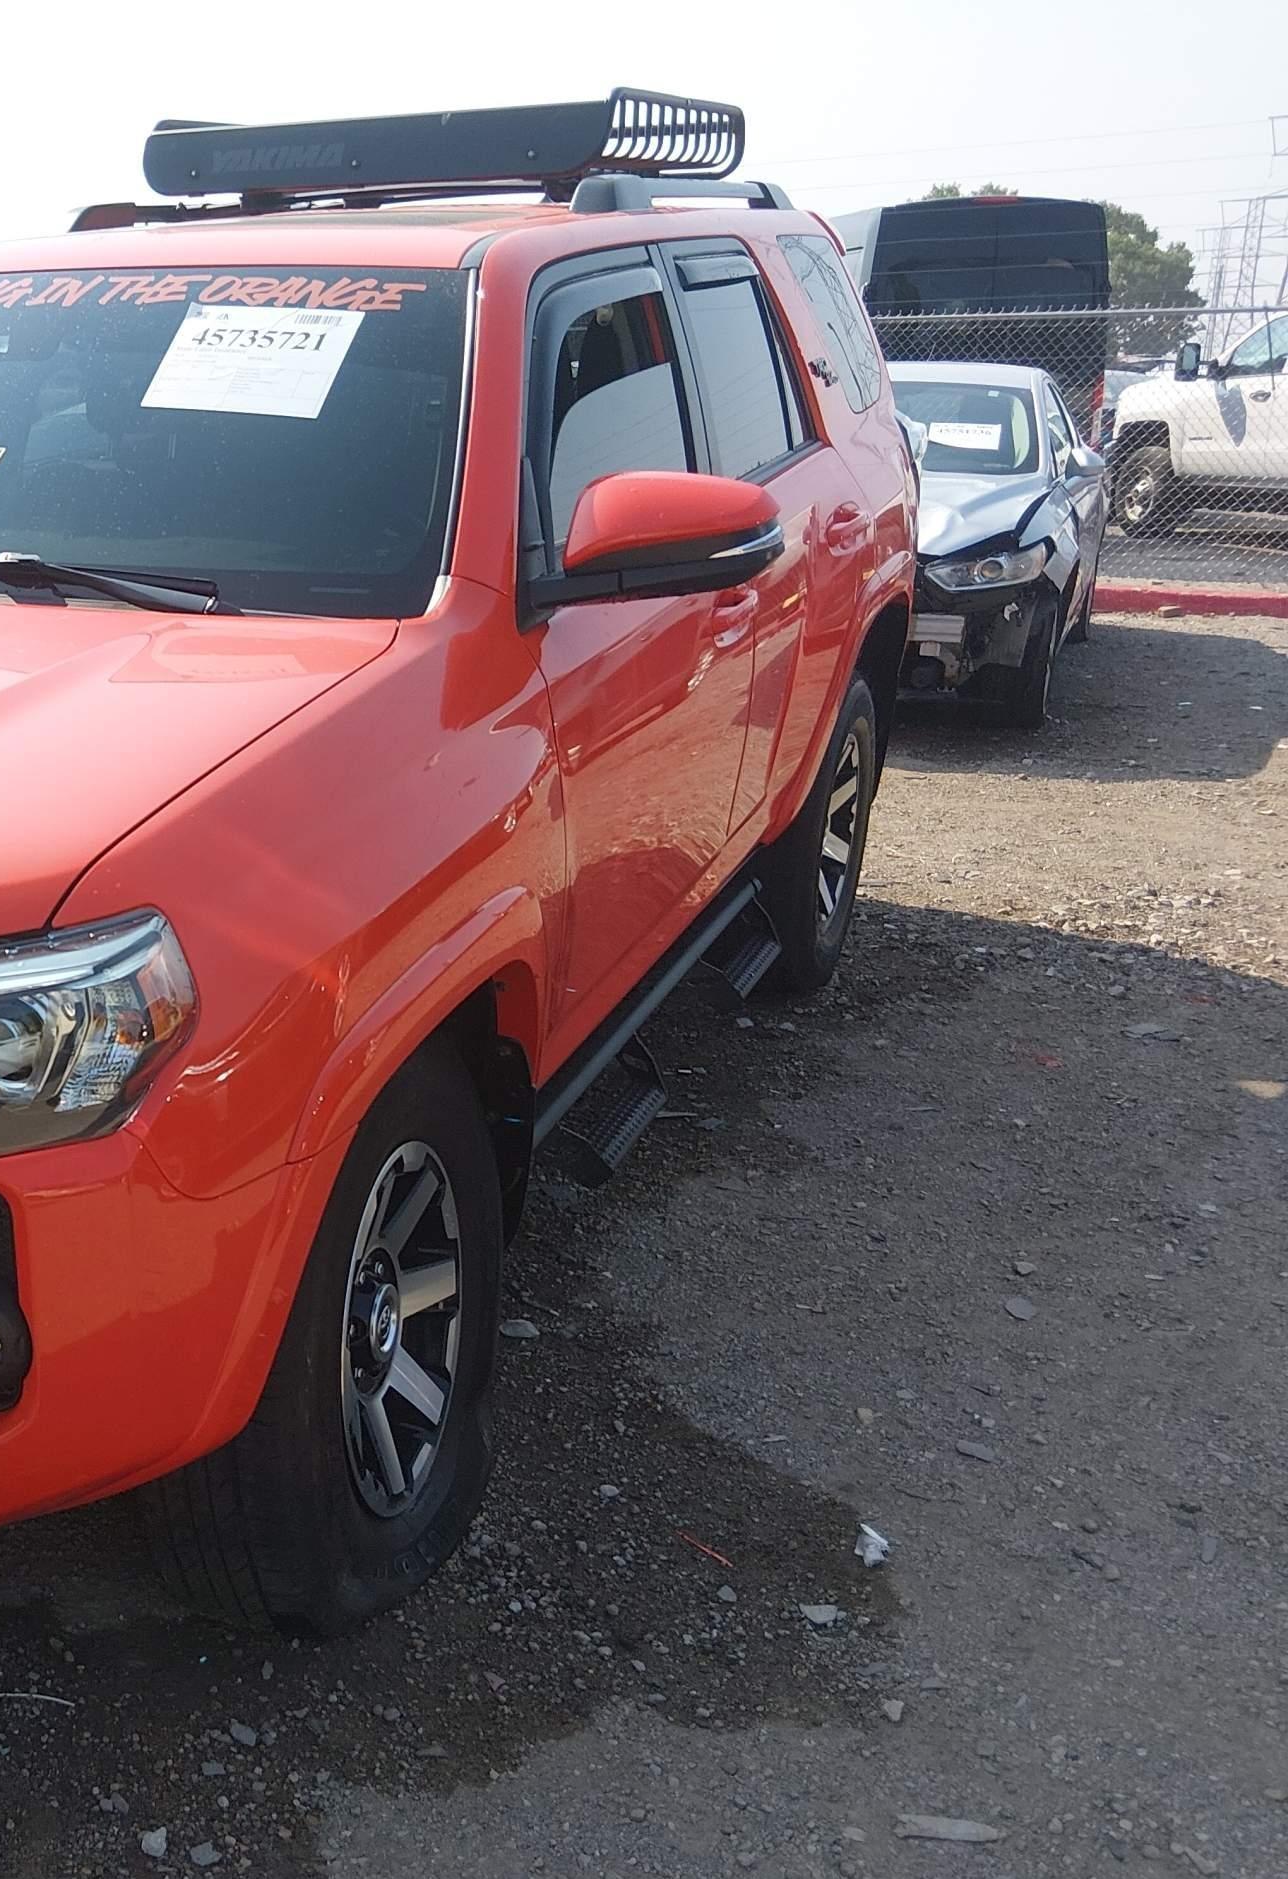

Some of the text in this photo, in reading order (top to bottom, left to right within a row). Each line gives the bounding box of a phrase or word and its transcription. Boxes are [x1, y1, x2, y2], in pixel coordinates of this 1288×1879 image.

[211, 143, 345, 175] YAKIMA
[25, 275, 85, 308] IN
[98, 273, 213, 305] THE
[198, 274, 427, 311] ORANGE
[191, 327, 328, 352] 45735721
